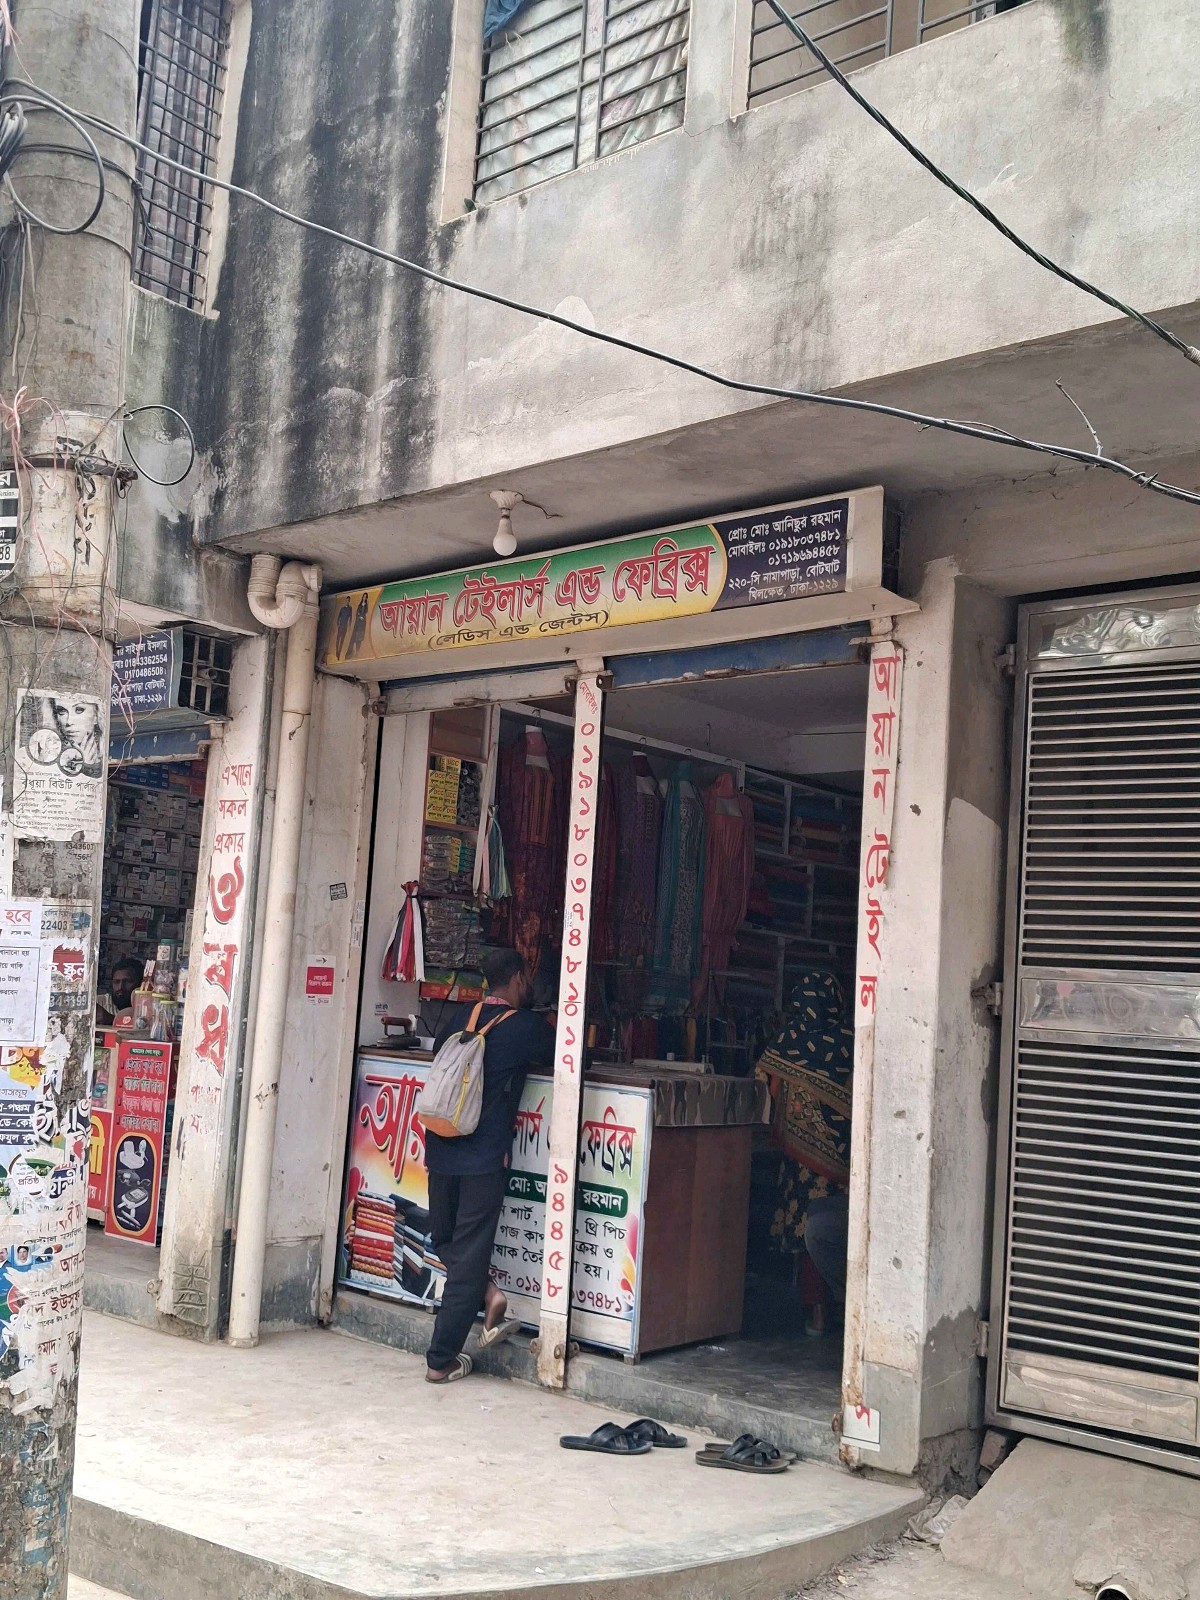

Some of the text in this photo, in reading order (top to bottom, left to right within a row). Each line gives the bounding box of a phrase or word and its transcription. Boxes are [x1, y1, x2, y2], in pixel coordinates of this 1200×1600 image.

[728, 509, 842, 542] প্রোঃ মোঃ আনিছুর রহমান
[727, 528, 841, 558] মোবাইলঃ ০১৯১৮০৩৭৪৮১
[768, 545, 840, 566] ০১৭১৯৬৯৪৪৫৮
[379, 537, 717, 639] আয়ান টেইলার্স এন্ড ফেব্রিক্স
[790, 578, 839, 596] ঢাকা-১২২৯
[427, 609, 609, 650] (লেডিস এন্ড জেন্টস)
[222, 763, 254, 786] এখানে
[219, 799, 249, 819] সকল
[214, 833, 246, 854] প্রকার
[4, 909, 33, 924] হবে
[583, 1189, 624, 1212] রহমান
[500, 1224, 521, 1240] গজ
[603, 1247, 614, 1259] ও
